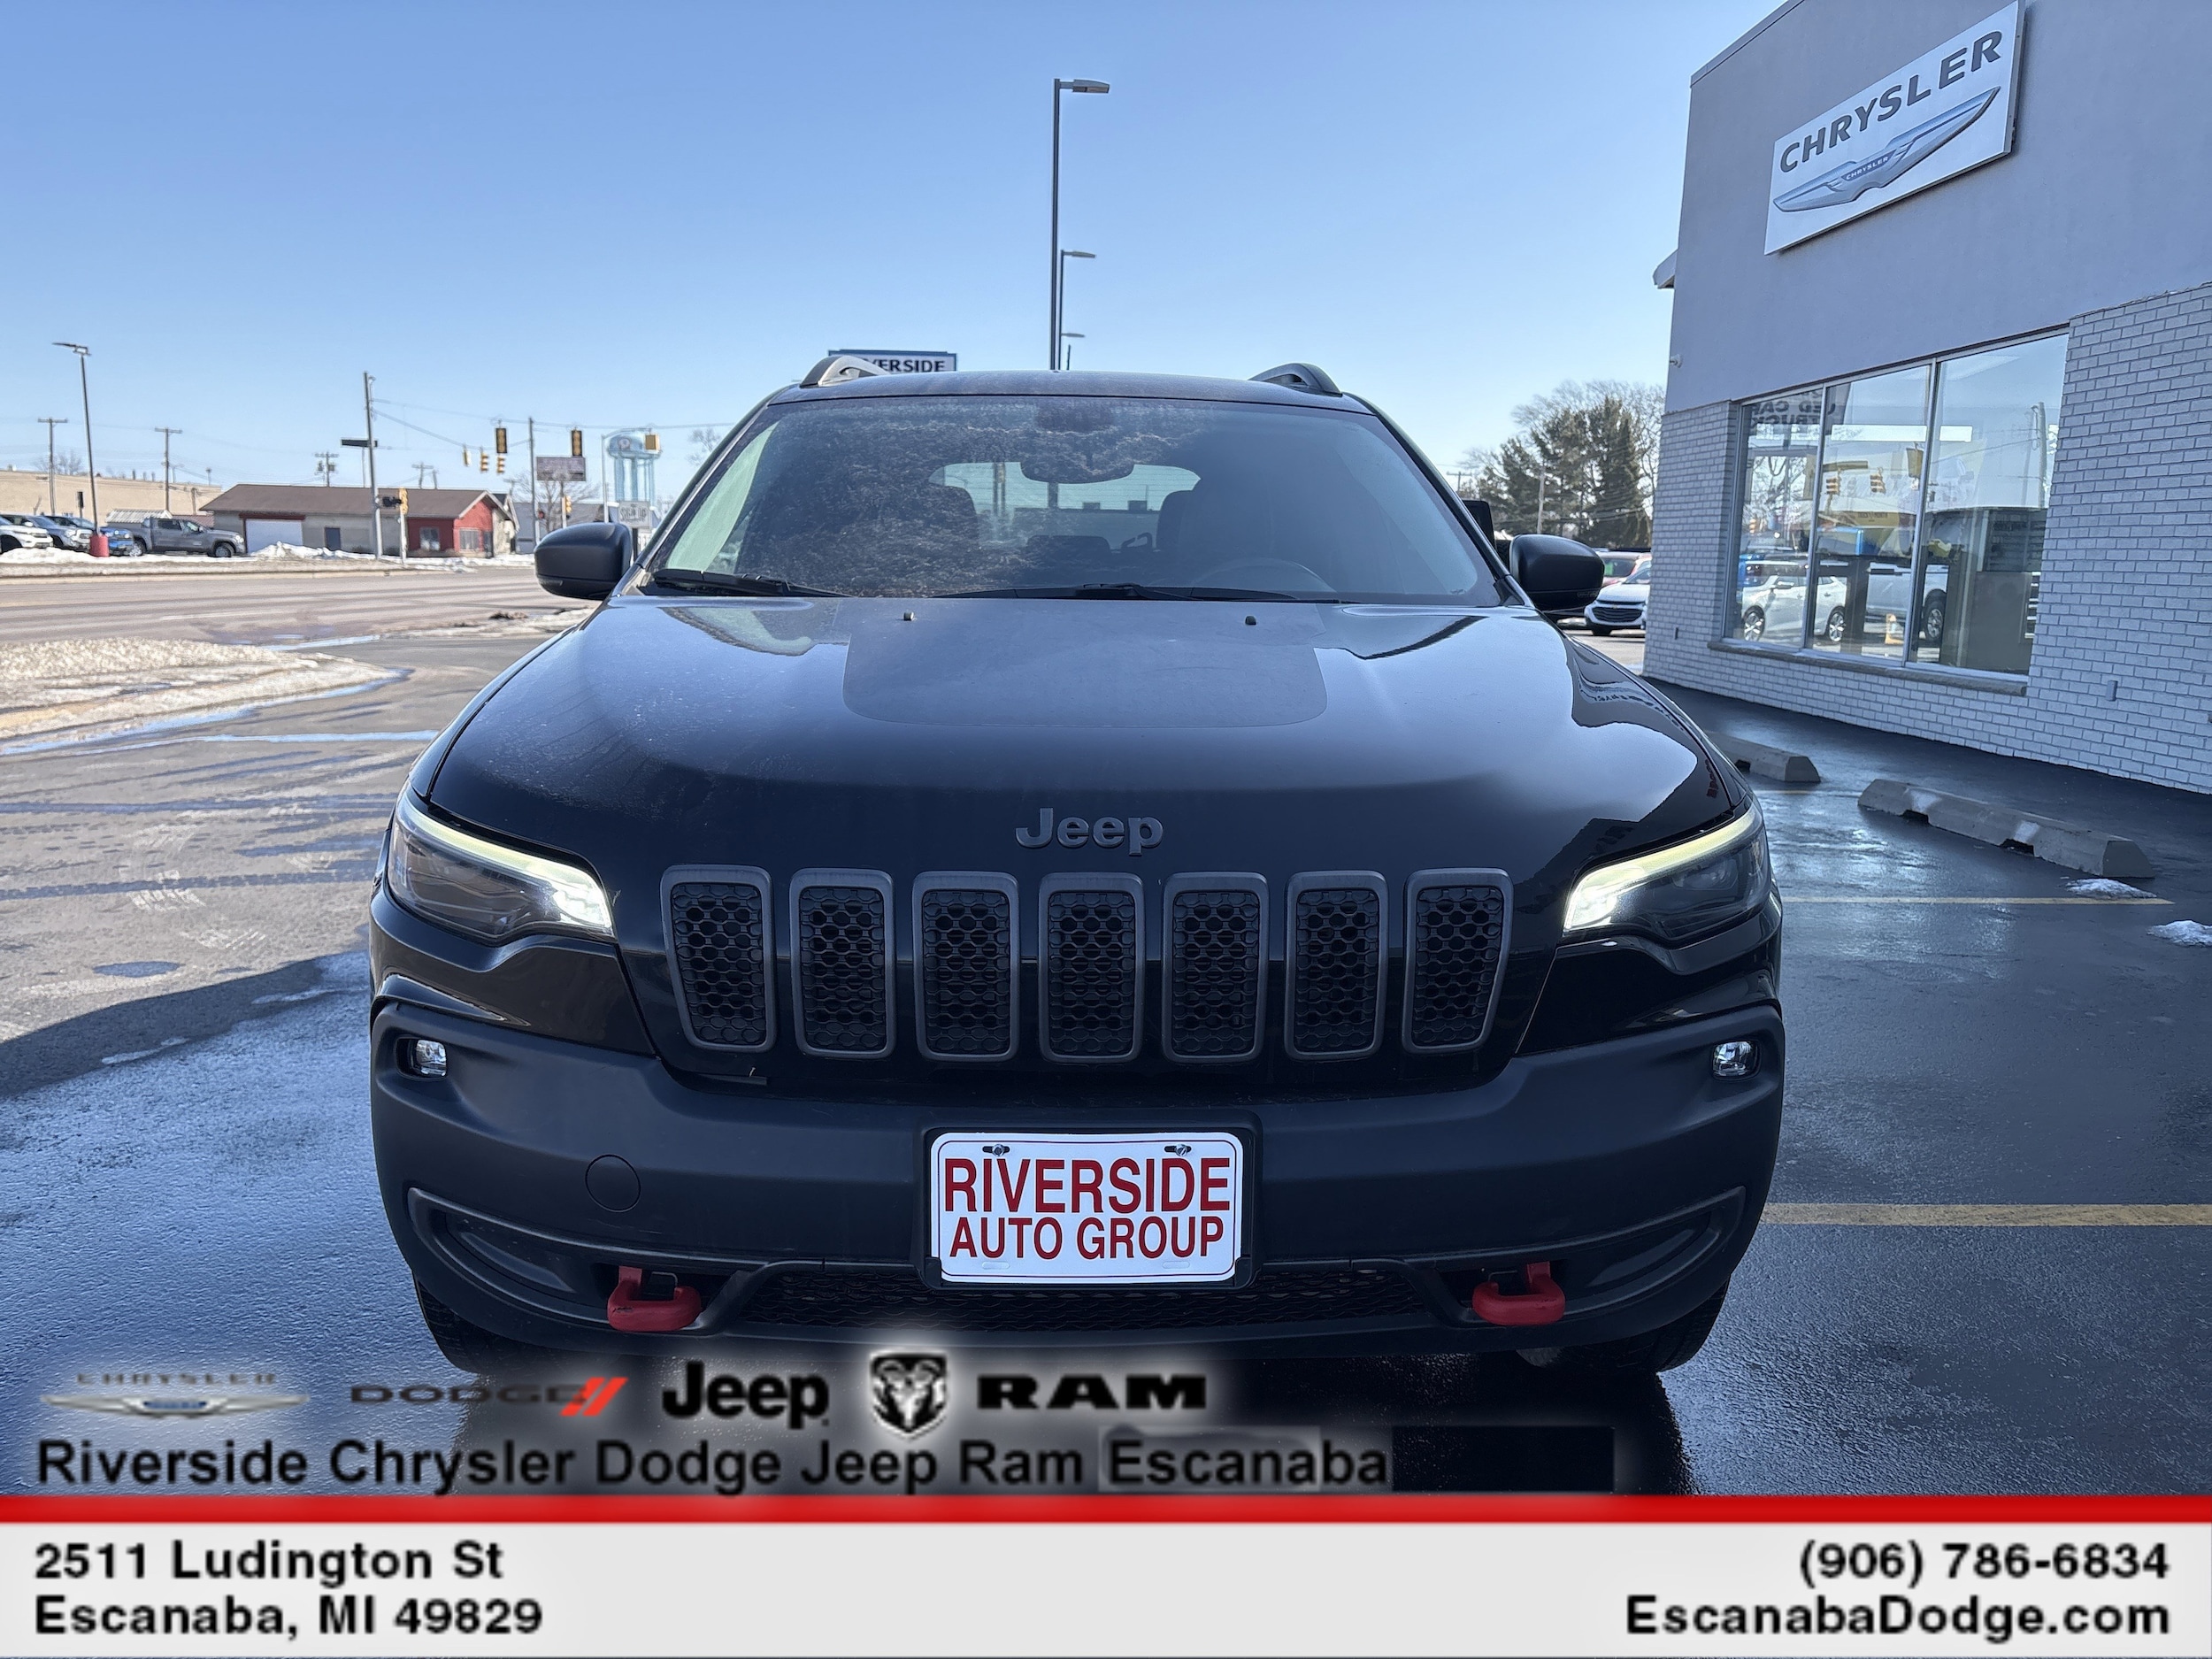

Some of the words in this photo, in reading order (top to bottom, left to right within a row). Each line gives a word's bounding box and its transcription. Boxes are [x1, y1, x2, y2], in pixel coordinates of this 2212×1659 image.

[1780, 31, 2002, 173] CHRYSLER
[1845, 156, 1888, 180] CHRYSLER
[864, 358, 945, 372] ERSIDE
[1015, 807, 1164, 856] Jeep
[944, 1157, 1230, 1213] RIVERSIDE
[949, 1217, 1063, 1259] AUTO
[1077, 1216, 1225, 1259] GROUP
